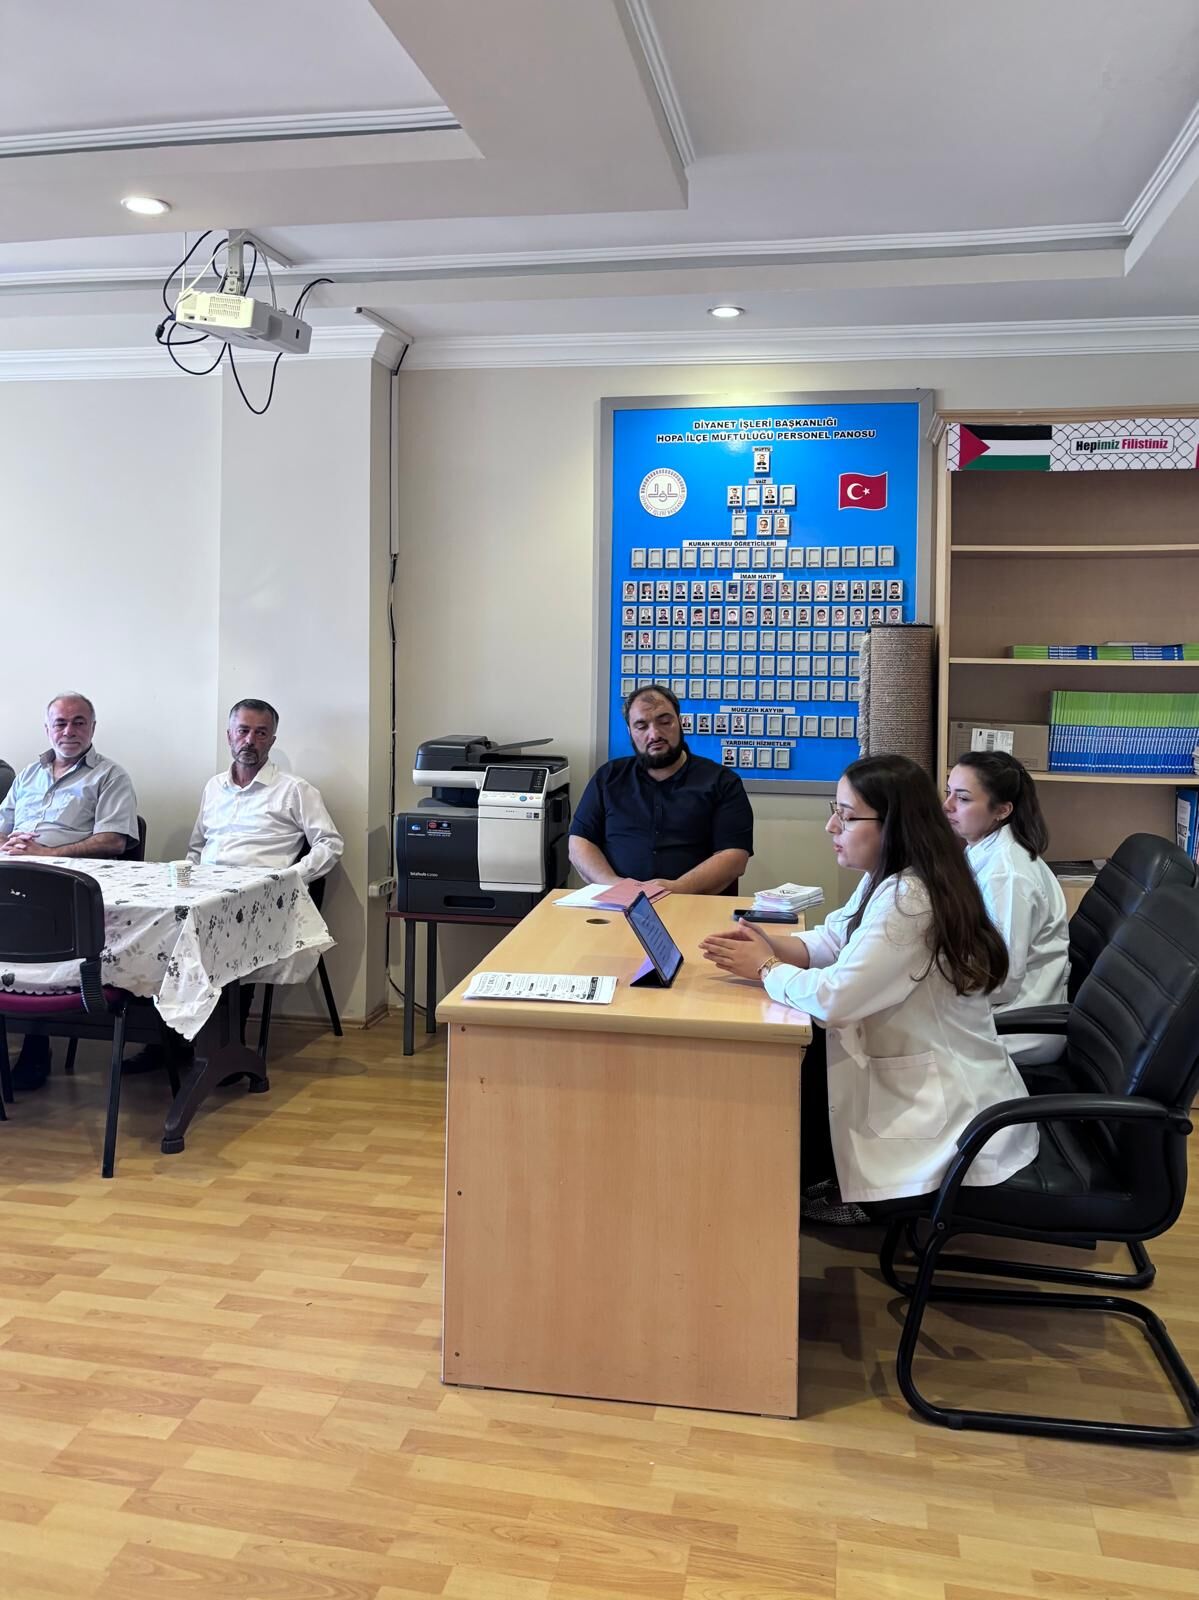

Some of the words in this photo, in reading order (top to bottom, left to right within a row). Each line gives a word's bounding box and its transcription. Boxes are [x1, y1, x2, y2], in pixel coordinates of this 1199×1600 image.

[694, 420, 736, 429] DİYANET
[740, 419, 772, 429] İŞLERİ
[775, 417, 837, 429] BAŞKANLIĞI
[657, 435, 684, 443] HOPA
[686, 432, 708, 443] İLÇE
[777, 431, 831, 440] PERSONEL
[833, 430, 876, 439] PANOSU
[1075, 439, 1120, 454] Hepimiz
[1121, 438, 1168, 450] Filistiniz
